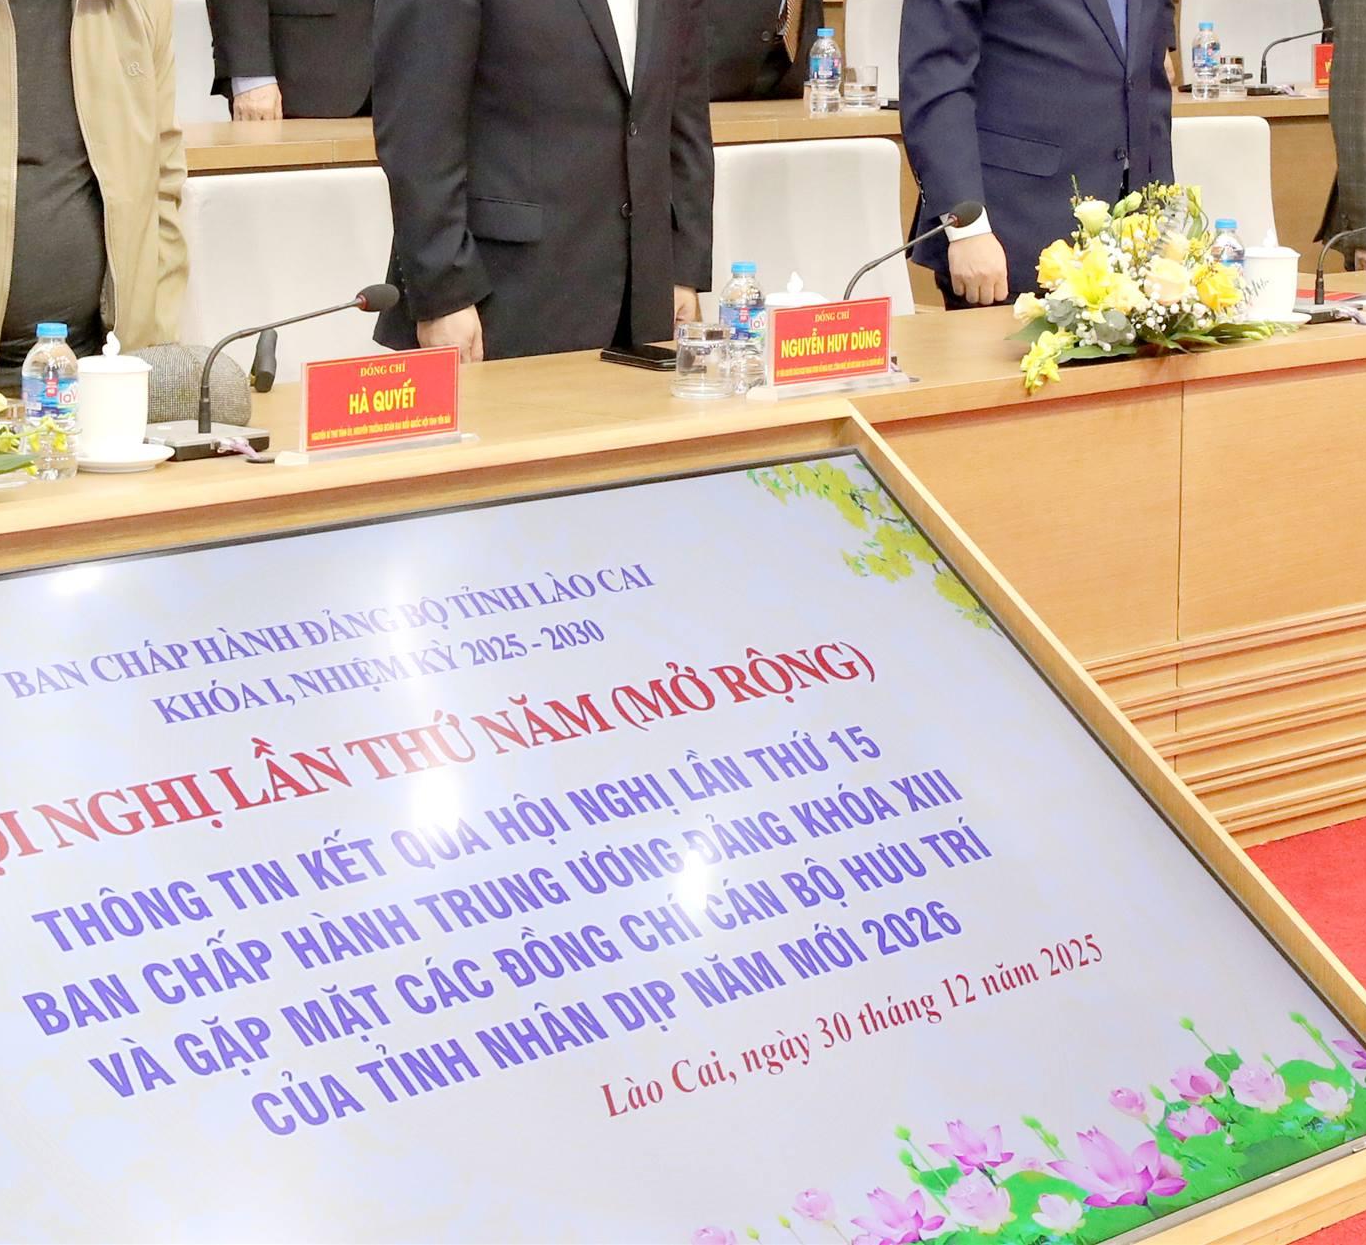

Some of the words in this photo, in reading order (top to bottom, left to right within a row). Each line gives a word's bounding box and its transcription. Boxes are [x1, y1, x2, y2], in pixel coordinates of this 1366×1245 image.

[349, 386, 370, 416] HÀ
[372, 378, 417, 414] QUYẾT
[360, 362, 387, 378] ĐỒNG
[389, 360, 406, 375] CHÍ
[781, 327, 825, 359] NGUYỄN
[827, 332, 849, 353] HUY
[851, 326, 882, 351] DŨNG
[0, 660, 90, 700] BAN
[91, 640, 201, 688] CHẤP
[192, 621, 301, 667] HÀNH
[298, 609, 400, 649] ĐẢNG
[403, 596, 450, 636] BỘ
[444, 585, 532, 621] TỈNH
[528, 572, 597, 608] LÀO
[596, 563, 657, 596] CAI
[151, 680, 276, 725] KHÓA
[265, 677, 296, 709] I,
[287, 657, 412, 701] NHIỆM
[412, 638, 459, 678] KỲ
[461, 632, 527, 667] 2025
[540, 619, 606, 652] 2030
[33, 774, 221, 849] NGHỊ
[210, 737, 351, 813] LẦN
[344, 709, 477, 781] THỨ
[472, 694, 617, 756] NĂM
[610, 661, 716, 734] (MỞ
[708, 641, 877, 705] RỘNG)
[22, 973, 141, 1037] BAN
[141, 929, 273, 1006] CHẤP
[281, 912, 421, 970] HÀNH
[415, 868, 571, 934] TRUNG
[565, 835, 686, 895] ƯƠNG
[682, 810, 798, 866] ĐẢNG
[789, 779, 900, 840] KHÓA
[890, 767, 964, 814] XIII
[32, 887, 214, 953] THÔNG
[206, 860, 301, 911] TIN
[296, 828, 387, 891] KẾT
[484, 793, 569, 848] HỘI
[567, 773, 680, 834] NGHỊ
[667, 750, 753, 803] LẦN
[743, 730, 832, 784] THỨ
[828, 725, 881, 762] 15
[87, 1037, 177, 1099] VÀ
[173, 1015, 273, 1077] GẶP
[280, 984, 391, 1047] MẶT
[394, 956, 495, 1015] CÁC
[493, 924, 624, 991] ĐỒNG
[619, 891, 703, 955] CHÍ
[700, 876, 788, 934] CÁN
[780, 857, 848, 911] BỘ
[839, 838, 930, 894] HƯU
[920, 817, 993, 870] TRÍ
[250, 1070, 366, 1138] CỦA
[355, 1038, 482, 1105] TỈNH
[475, 1000, 611, 1071] NHÂN
[604, 978, 677, 1034] DỊP
[681, 952, 788, 1010] NĂM
[777, 920, 870, 980] MỚI
[863, 900, 963, 956] 2026
[600, 1074, 666, 1119] Lào
[669, 1051, 739, 1095] Cai,
[740, 1028, 814, 1078] ngày
[815, 1009, 854, 1052] 30
[856, 987, 943, 1034] tháng
[944, 972, 978, 1009] 12
[981, 959, 1042, 998] năm
[1040, 932, 1105, 978] 2025
